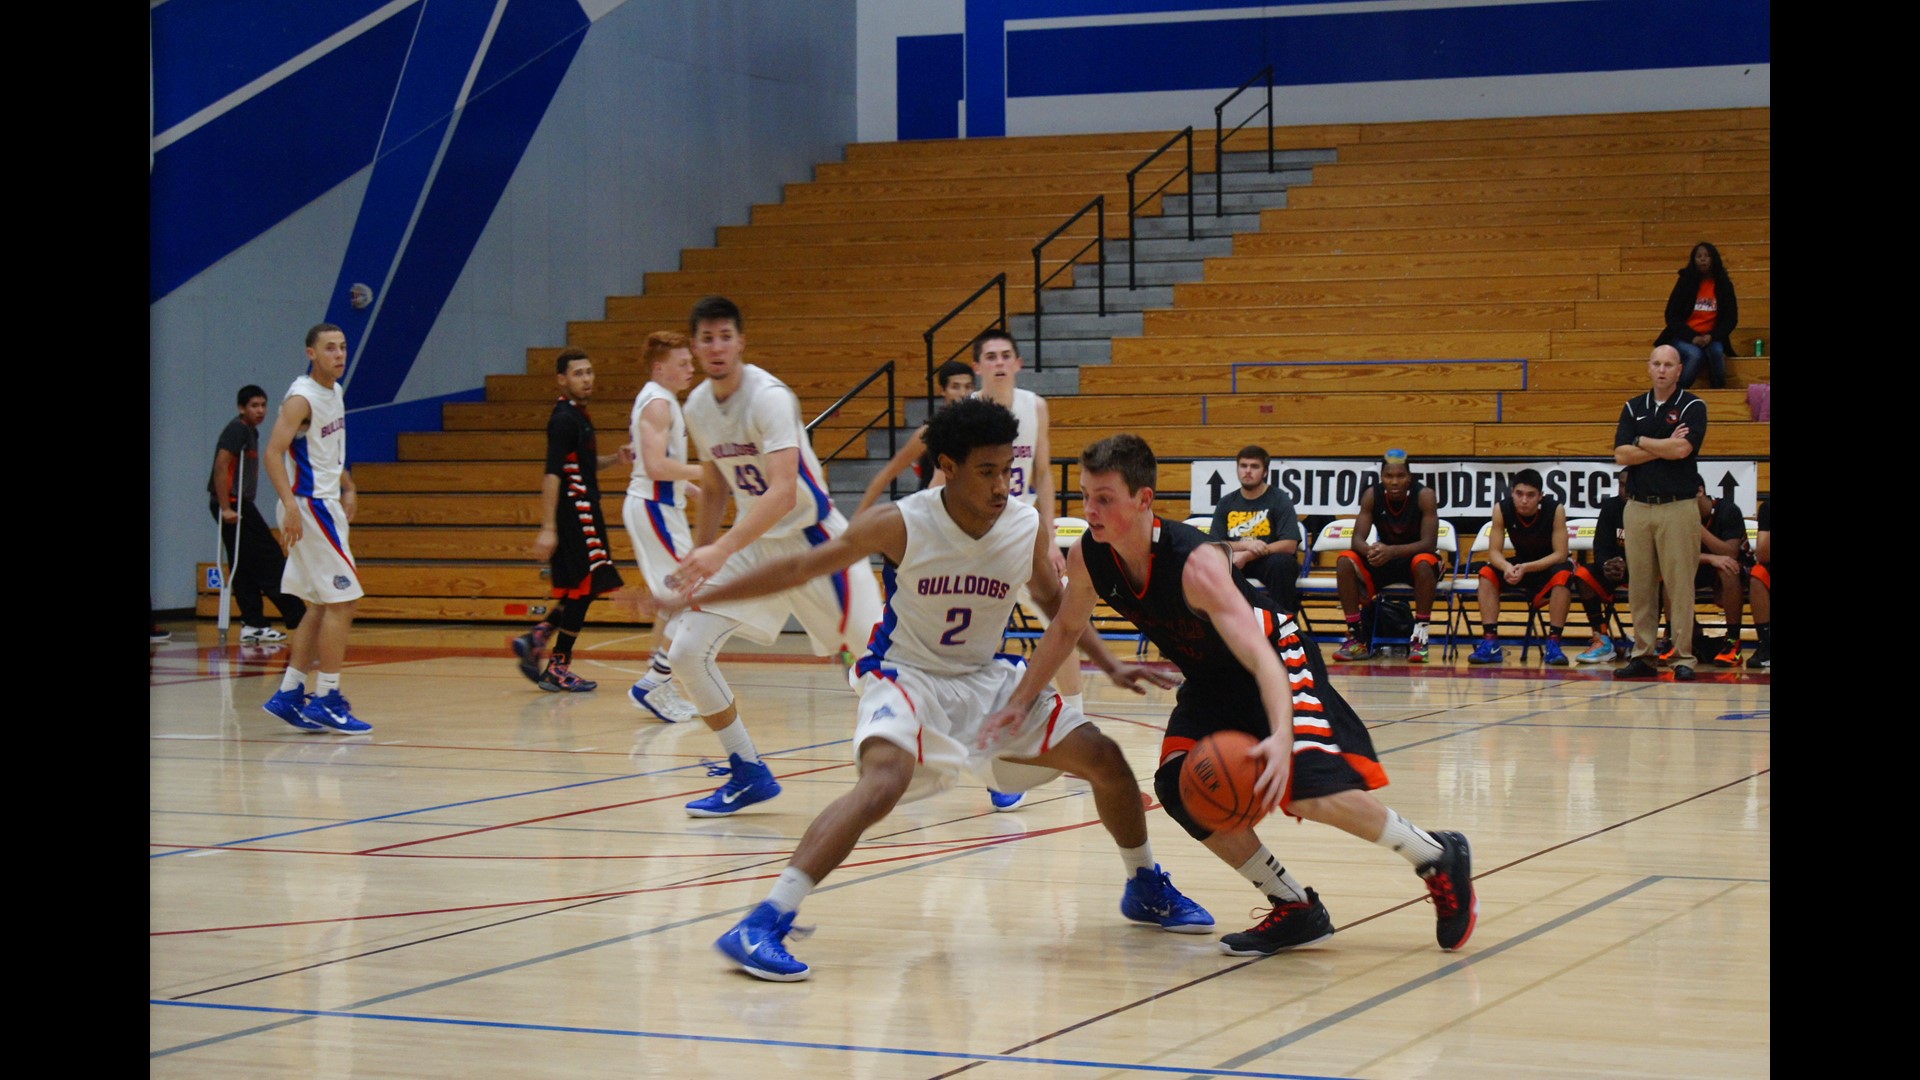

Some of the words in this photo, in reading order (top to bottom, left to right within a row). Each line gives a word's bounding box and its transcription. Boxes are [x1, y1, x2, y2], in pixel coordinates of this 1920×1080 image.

[320, 417, 344, 438] BULLD
[734, 463, 769, 496] 43
[1268, 469, 1380, 506] ISITOR
[1411, 471, 1516, 509] UDEN
[917, 575, 1010, 600] BULLDOGS
[940, 607, 972, 646] 2
